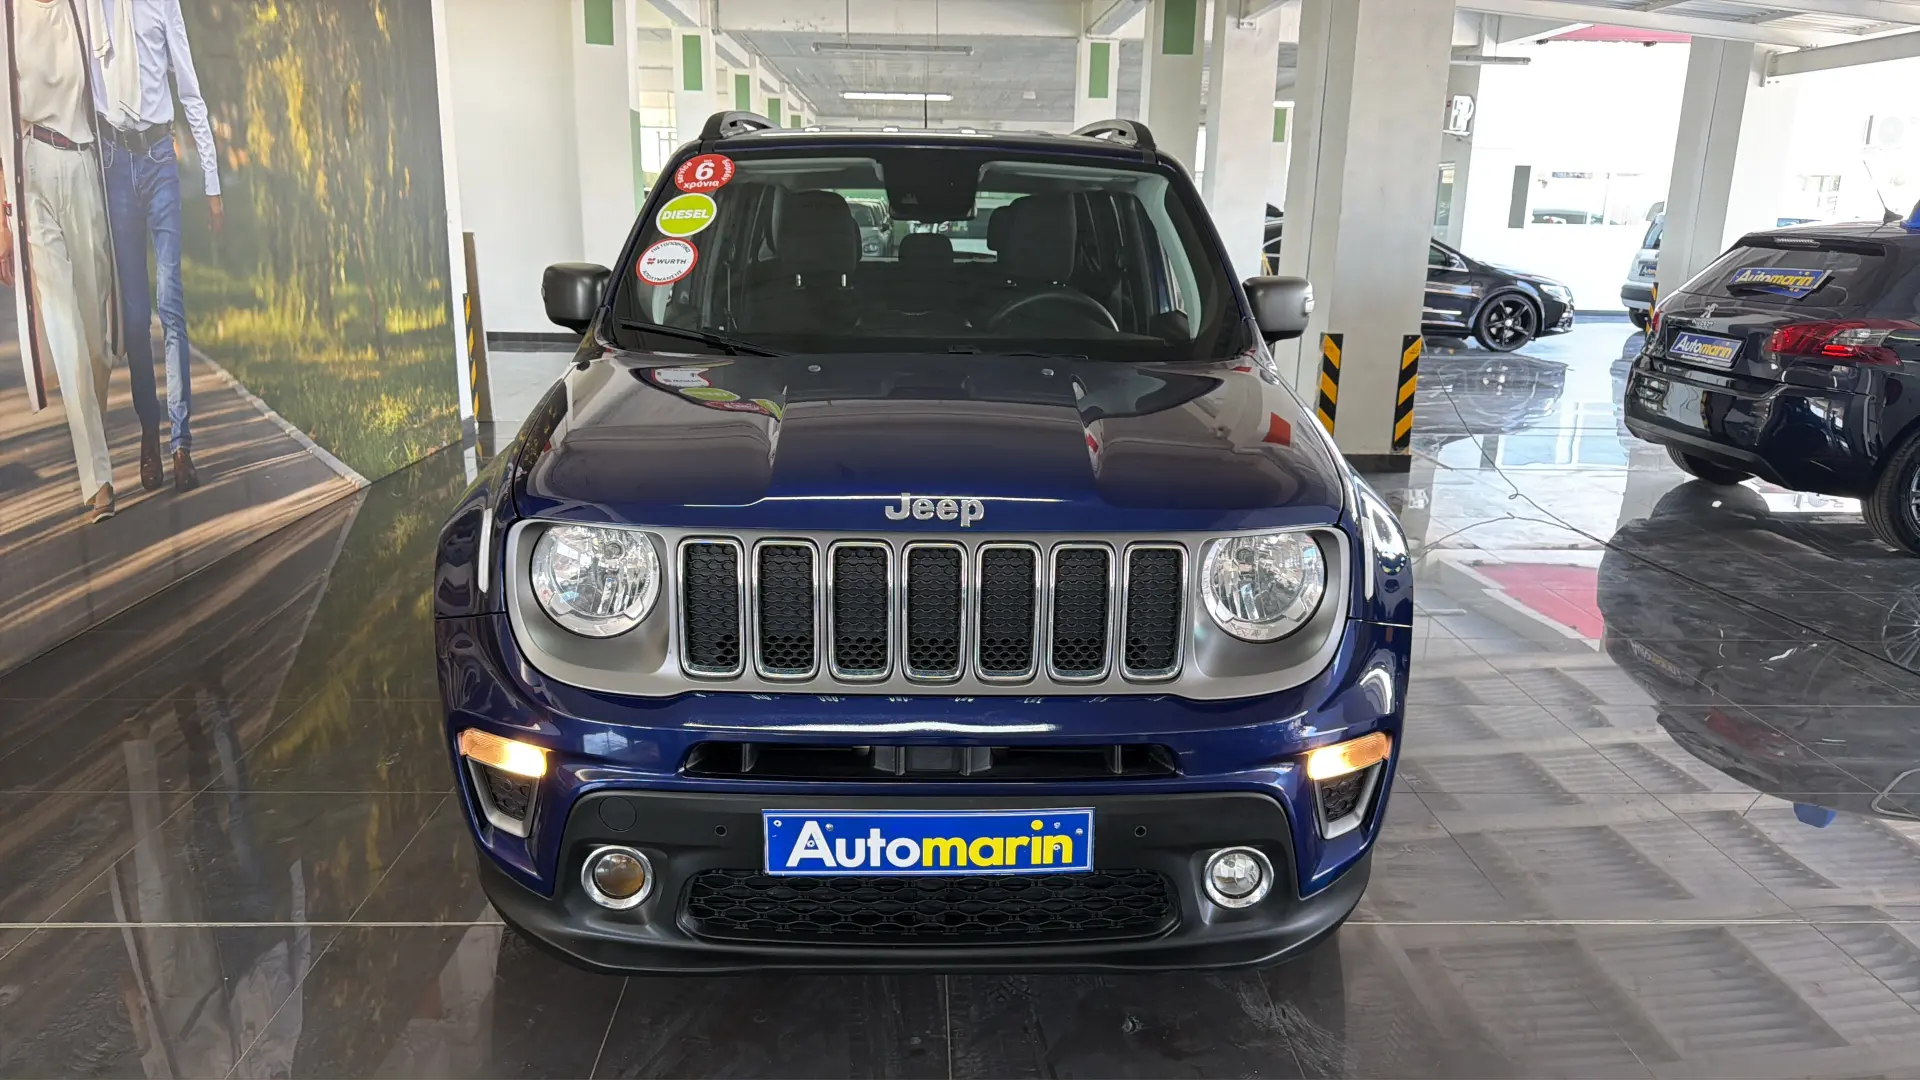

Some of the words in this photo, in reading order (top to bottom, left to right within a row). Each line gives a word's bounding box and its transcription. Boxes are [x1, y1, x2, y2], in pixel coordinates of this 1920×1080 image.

[695, 162, 715, 180] 6
[683, 180, 720, 189] χρόνια
[662, 209, 709, 220] DIESEL
[1736, 269, 1815, 286] Automarin
[1674, 334, 1733, 359] Automarin
[885, 492, 985, 528] Jeep
[786, 819, 1073, 868] Automarin
